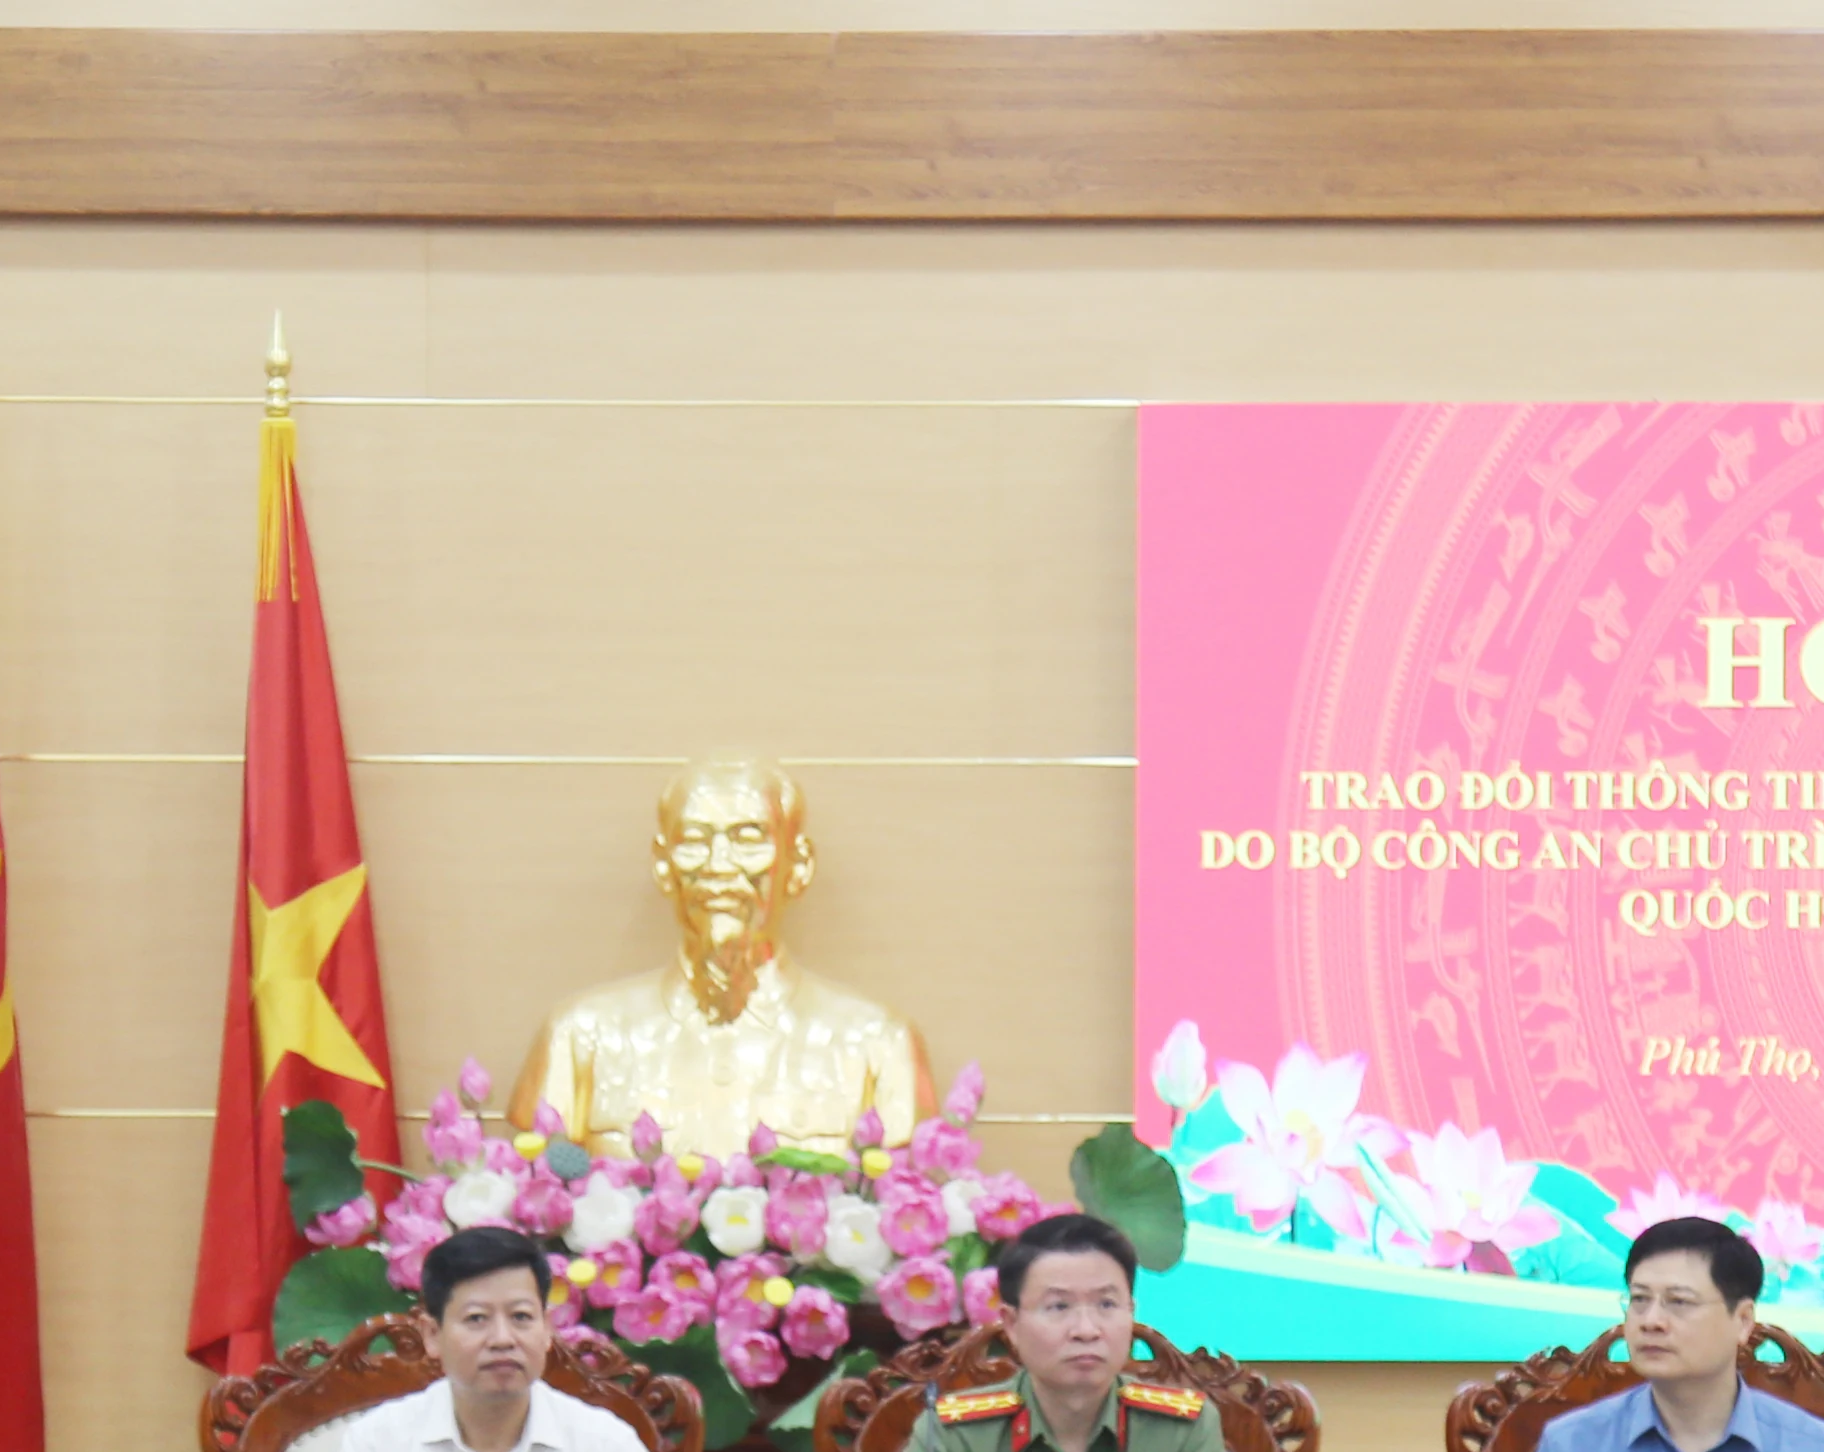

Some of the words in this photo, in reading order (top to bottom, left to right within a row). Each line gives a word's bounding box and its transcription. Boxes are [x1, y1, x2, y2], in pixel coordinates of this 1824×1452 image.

[1300, 770, 1446, 812] TRAO
[1459, 761, 1553, 811] ĐỔI
[1564, 760, 1750, 811] THÔNG
[1200, 829, 1276, 871] DO
[1289, 824, 1362, 880] BỘ
[1371, 818, 1520, 871] CÔNG
[1532, 830, 1603, 870] AN
[1616, 819, 1728, 871] CHỦ
[1619, 879, 1771, 937] QUỐC
[1639, 1036, 1723, 1077] Phú
[1738, 1036, 1821, 1083] Thọ,
